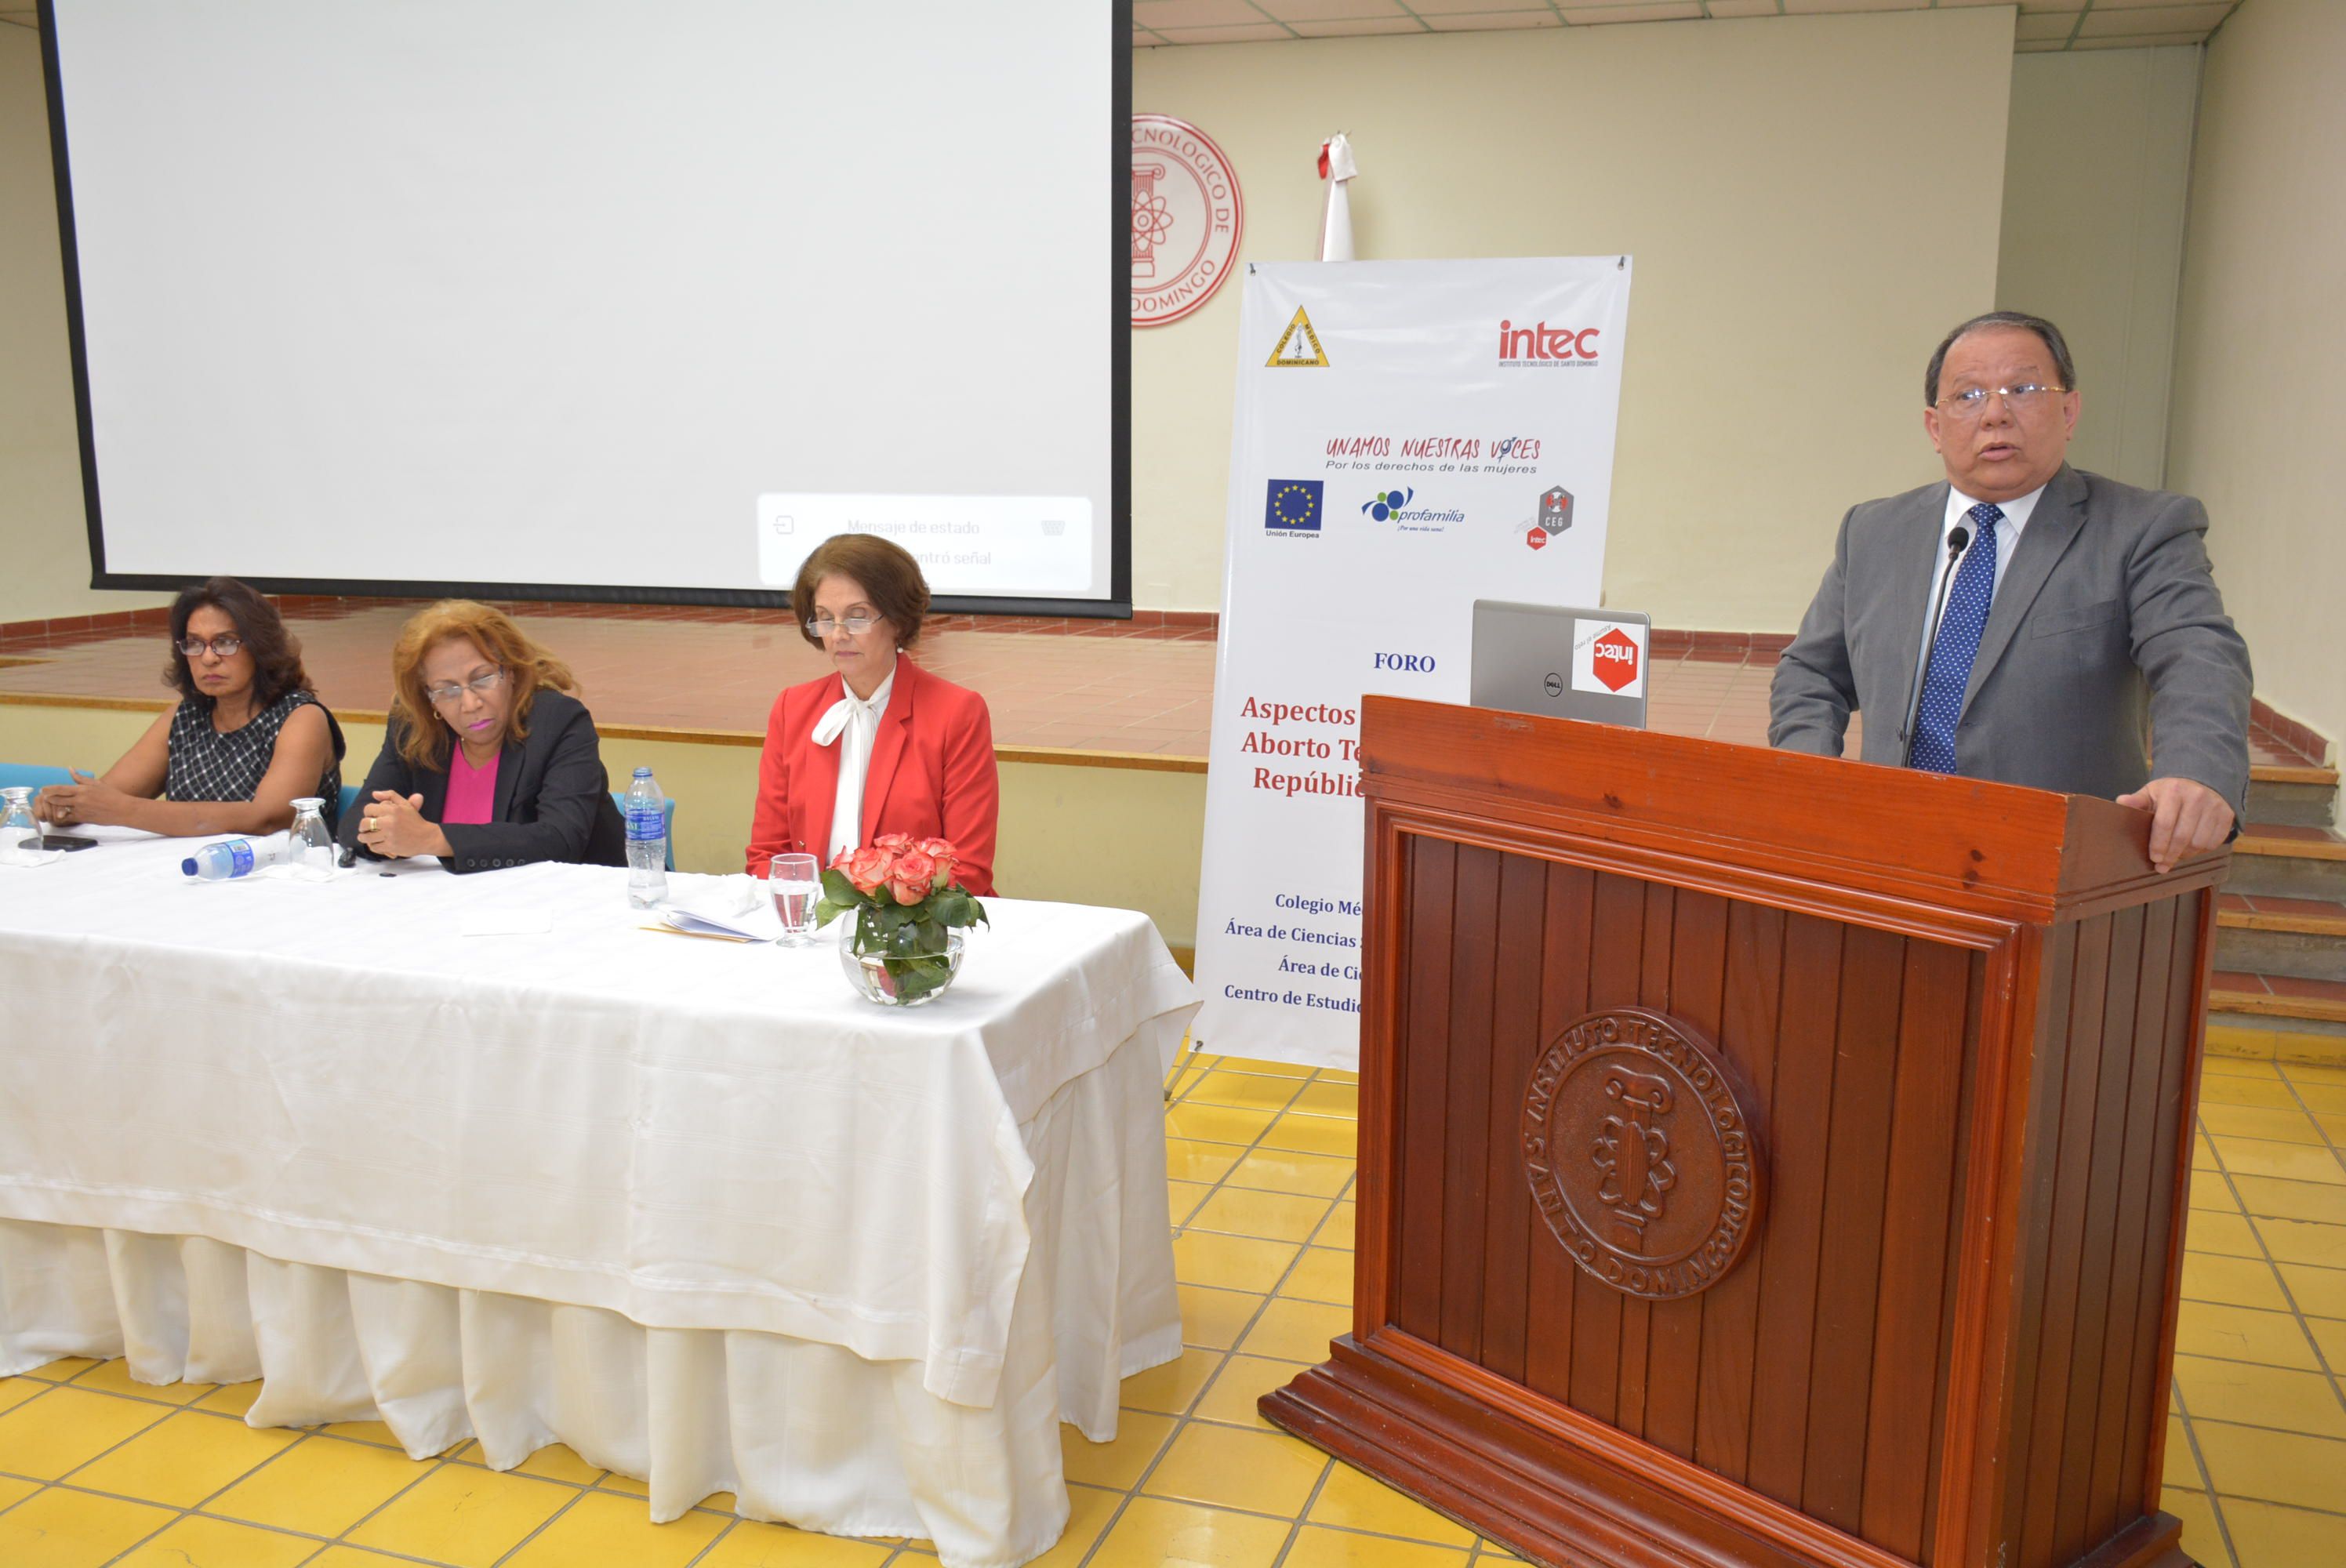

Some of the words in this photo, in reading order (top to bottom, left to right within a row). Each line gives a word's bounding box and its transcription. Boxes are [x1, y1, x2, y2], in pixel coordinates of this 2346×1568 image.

[1132, 129, 1226, 200] CNOLOGICO
[1215, 209, 1229, 233] DE
[1276, 323, 1296, 354] COLEGIO
[1305, 323, 1320, 354] MEDICO
[1499, 320, 1600, 359] intec
[1327, 436, 1390, 458] UNAMOS
[1401, 437, 1480, 460] NUESTRAS
[1325, 460, 1348, 470] Por
[1352, 461, 1371, 470] los
[1375, 462, 1434, 471] derechos
[1439, 462, 1454, 471] de
[1460, 463, 1479, 472] las
[1484, 464, 1537, 474] mujeres
[1397, 509, 1465, 523] profamilia
[1545, 517, 1563, 527] CEG
[848, 520, 906, 536] Mensaje
[910, 521, 927, 533] de
[930, 521, 979, 534] estado
[1289, 531, 1320, 539] Europea
[954, 552, 991, 564] señal
[1374, 652, 1436, 673] FORO
[1595, 643, 1633, 665] intec
[1240, 696, 1356, 726] Aspectos
[1240, 731, 1331, 759] Aborto
[1275, 894, 1334, 915] Colegio
[1338, 901, 1363, 916] Mé
[1225, 917, 1262, 937] Área
[1267, 925, 1287, 939] de
[1291, 927, 1356, 948] Ciencias
[1278, 955, 1316, 975] Área
[1320, 963, 1339, 978] de
[1225, 985, 1278, 1003] Centro
[1283, 991, 1302, 1005] de
[1527, 1017, 1619, 1122] INSTITUTO
[1629, 1019, 1749, 1200] TECNOLOGICO
[1526, 1136, 1596, 1264] SANTO
